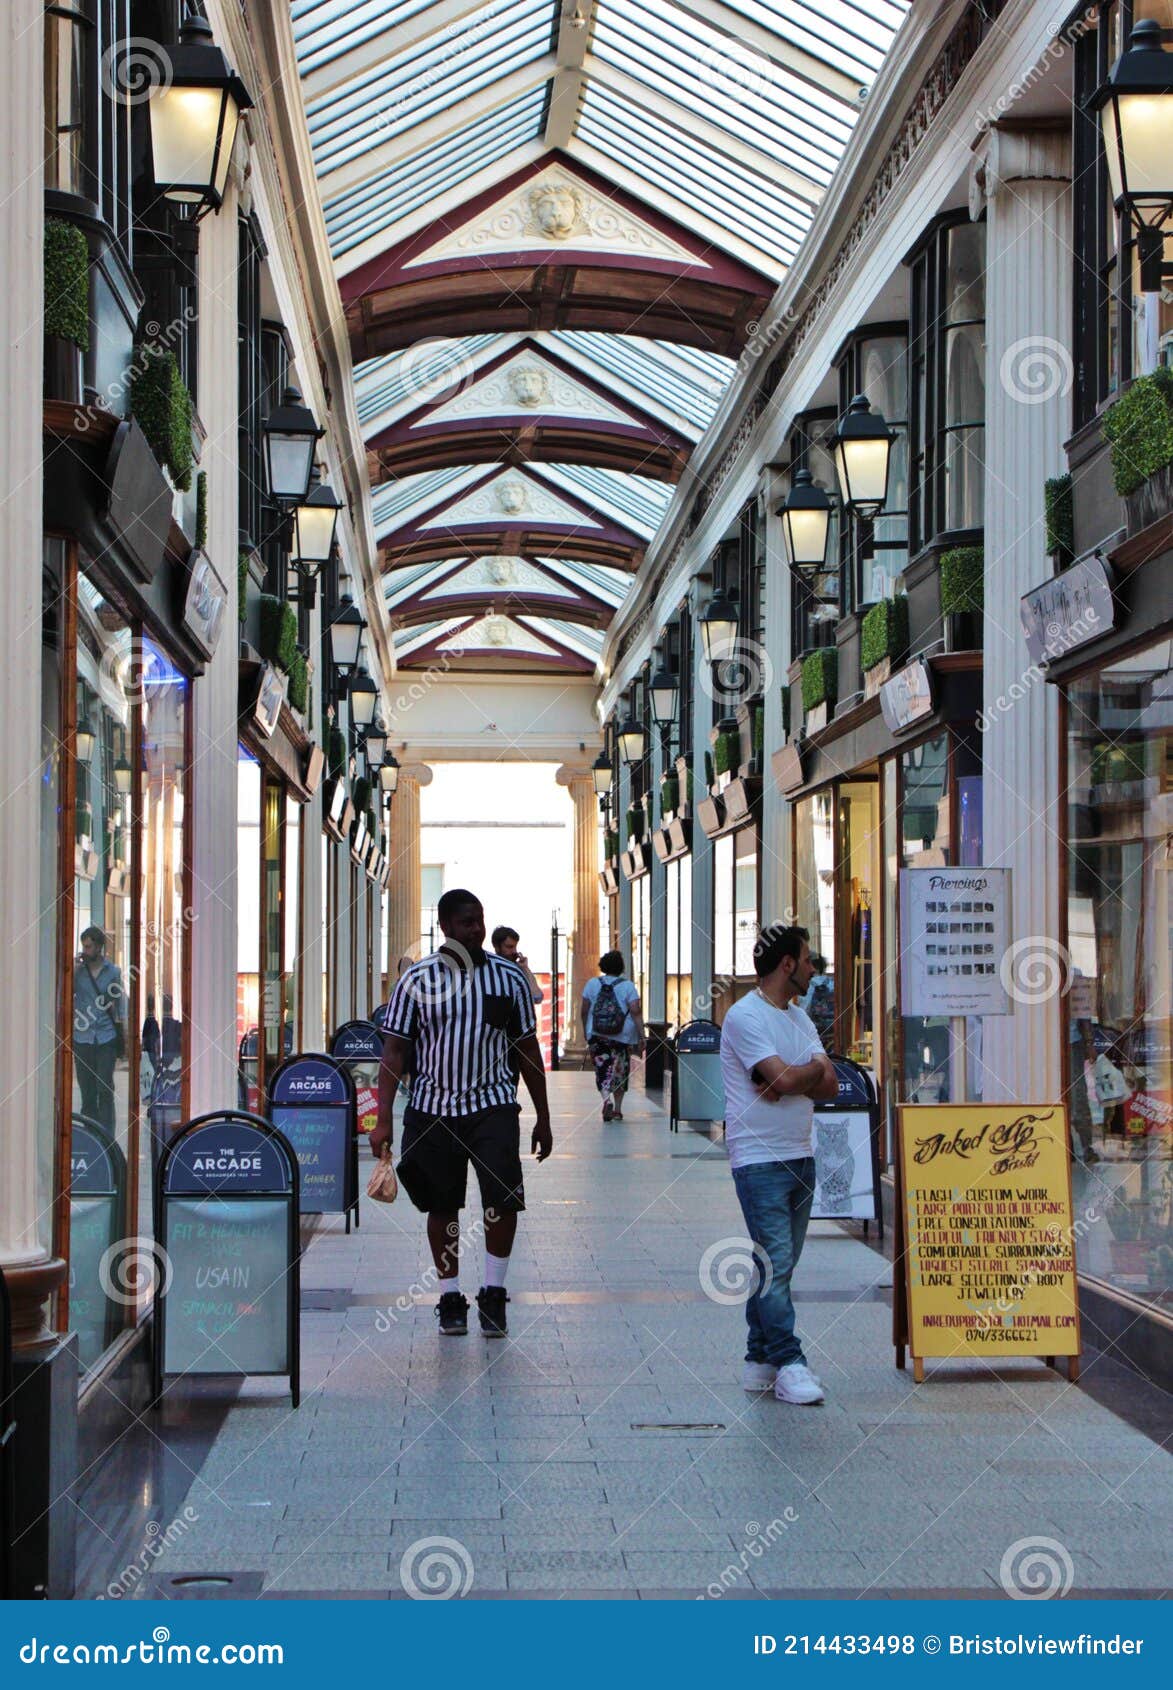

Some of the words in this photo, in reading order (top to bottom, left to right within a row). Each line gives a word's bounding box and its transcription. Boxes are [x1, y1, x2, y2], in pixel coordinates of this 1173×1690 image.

[929, 876, 988, 891] Piercings
[289, 1082, 332, 1090] ARCADE
[193, 1158, 262, 1170] ARCADE
[916, 1189, 952, 1201] FLASH
[966, 1189, 1013, 1201] CUSTOM
[1016, 1189, 1048, 1201] WORK
[916, 1202, 947, 1215] LARGE
[952, 1202, 1006, 1215] PORTFOLIO
[1022, 1202, 1065, 1215] DESIGNS
[917, 1217, 945, 1230] FREE
[950, 1216, 1035, 1229] CONSULTATIONS
[976, 1230, 1026, 1244] FRIENDLY
[918, 1246, 989, 1259] COMFORTABLE
[920, 1259, 963, 1273] HIGHEST
[969, 1259, 1009, 1273] STERILE
[1016, 1259, 1073, 1273] STANDARDS
[195, 1266, 251, 1289] USAIN
[921, 1274, 953, 1287] LARGE
[961, 1274, 1018, 1287] SELECTION
[1037, 1274, 1065, 1286] BODY
[957, 1287, 1026, 1300] JEWELLERY
